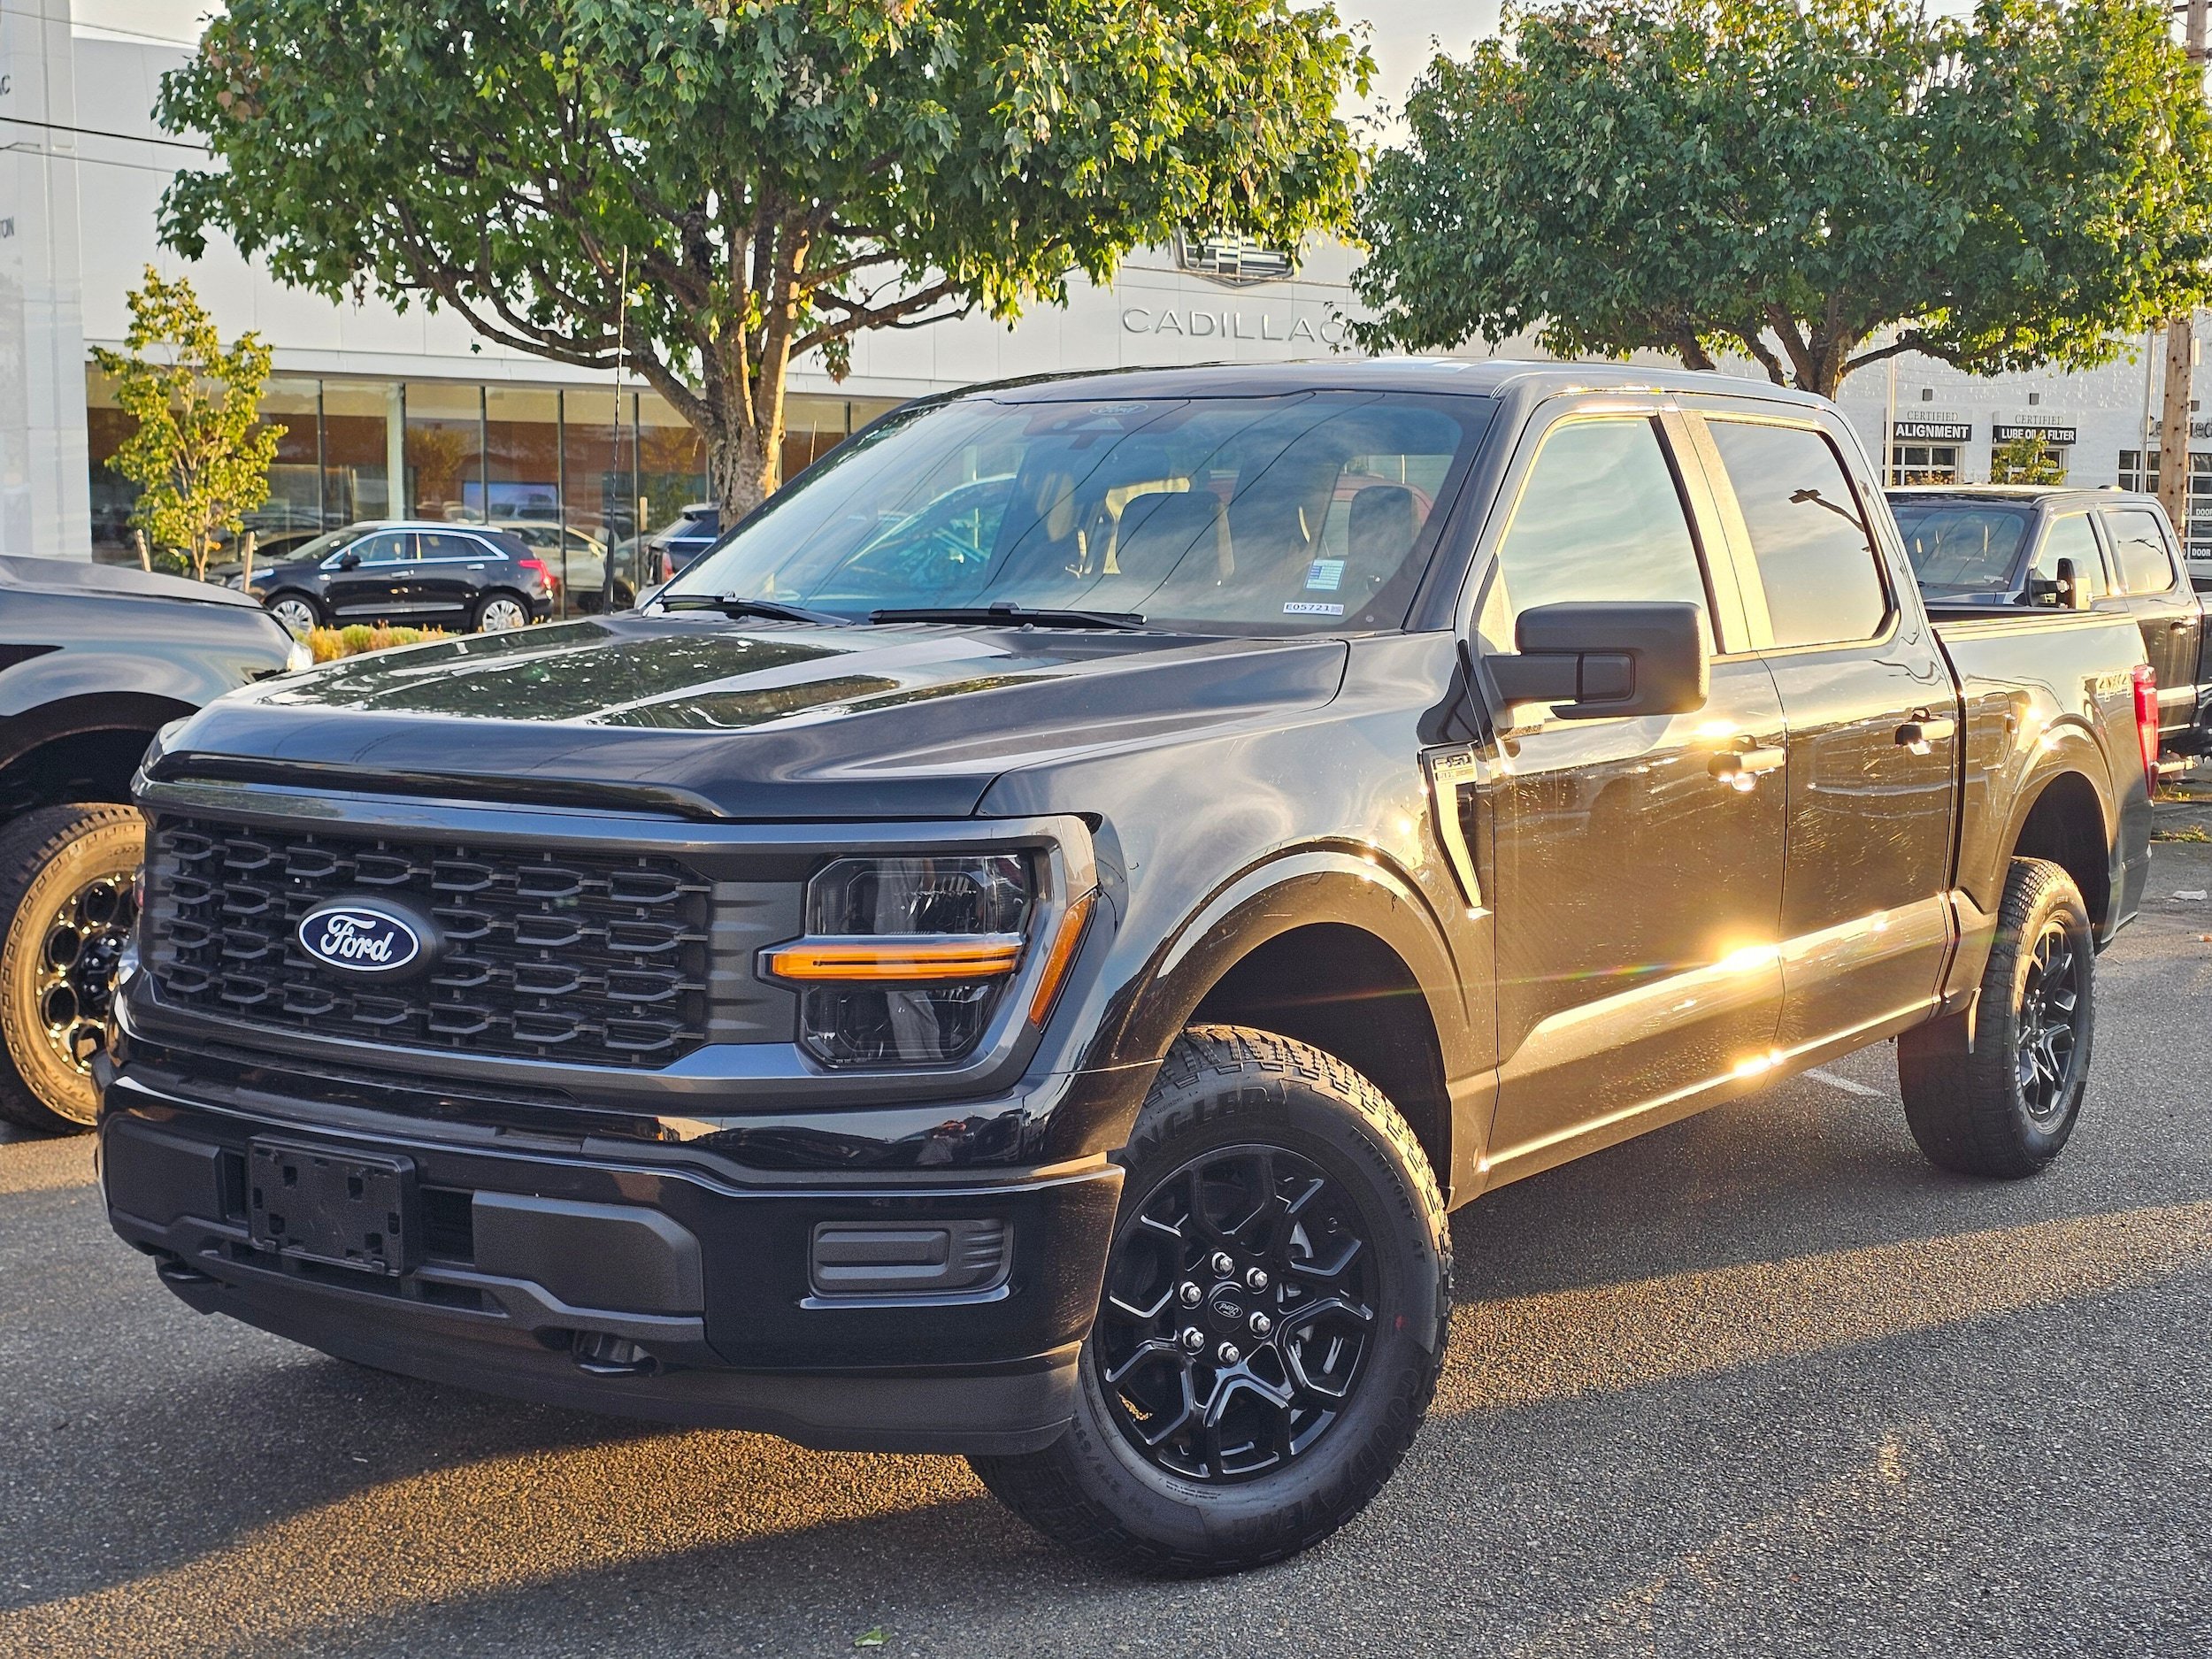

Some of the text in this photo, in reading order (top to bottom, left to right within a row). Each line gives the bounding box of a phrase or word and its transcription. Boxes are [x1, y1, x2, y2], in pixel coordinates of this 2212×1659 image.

[1123, 307, 1348, 344] CADILLAC
[1907, 410, 1959, 422] CERTIFIED
[2015, 414, 2064, 426] CERTIFIED
[1895, 423, 1969, 439] ALIGNMENT
[2001, 427, 2024, 440] LUBE
[2047, 429, 2075, 442] FILTER
[2192, 548, 2211, 557] DOOR
[1286, 603, 1330, 612] E05721
[320, 914, 395, 963] Ford
